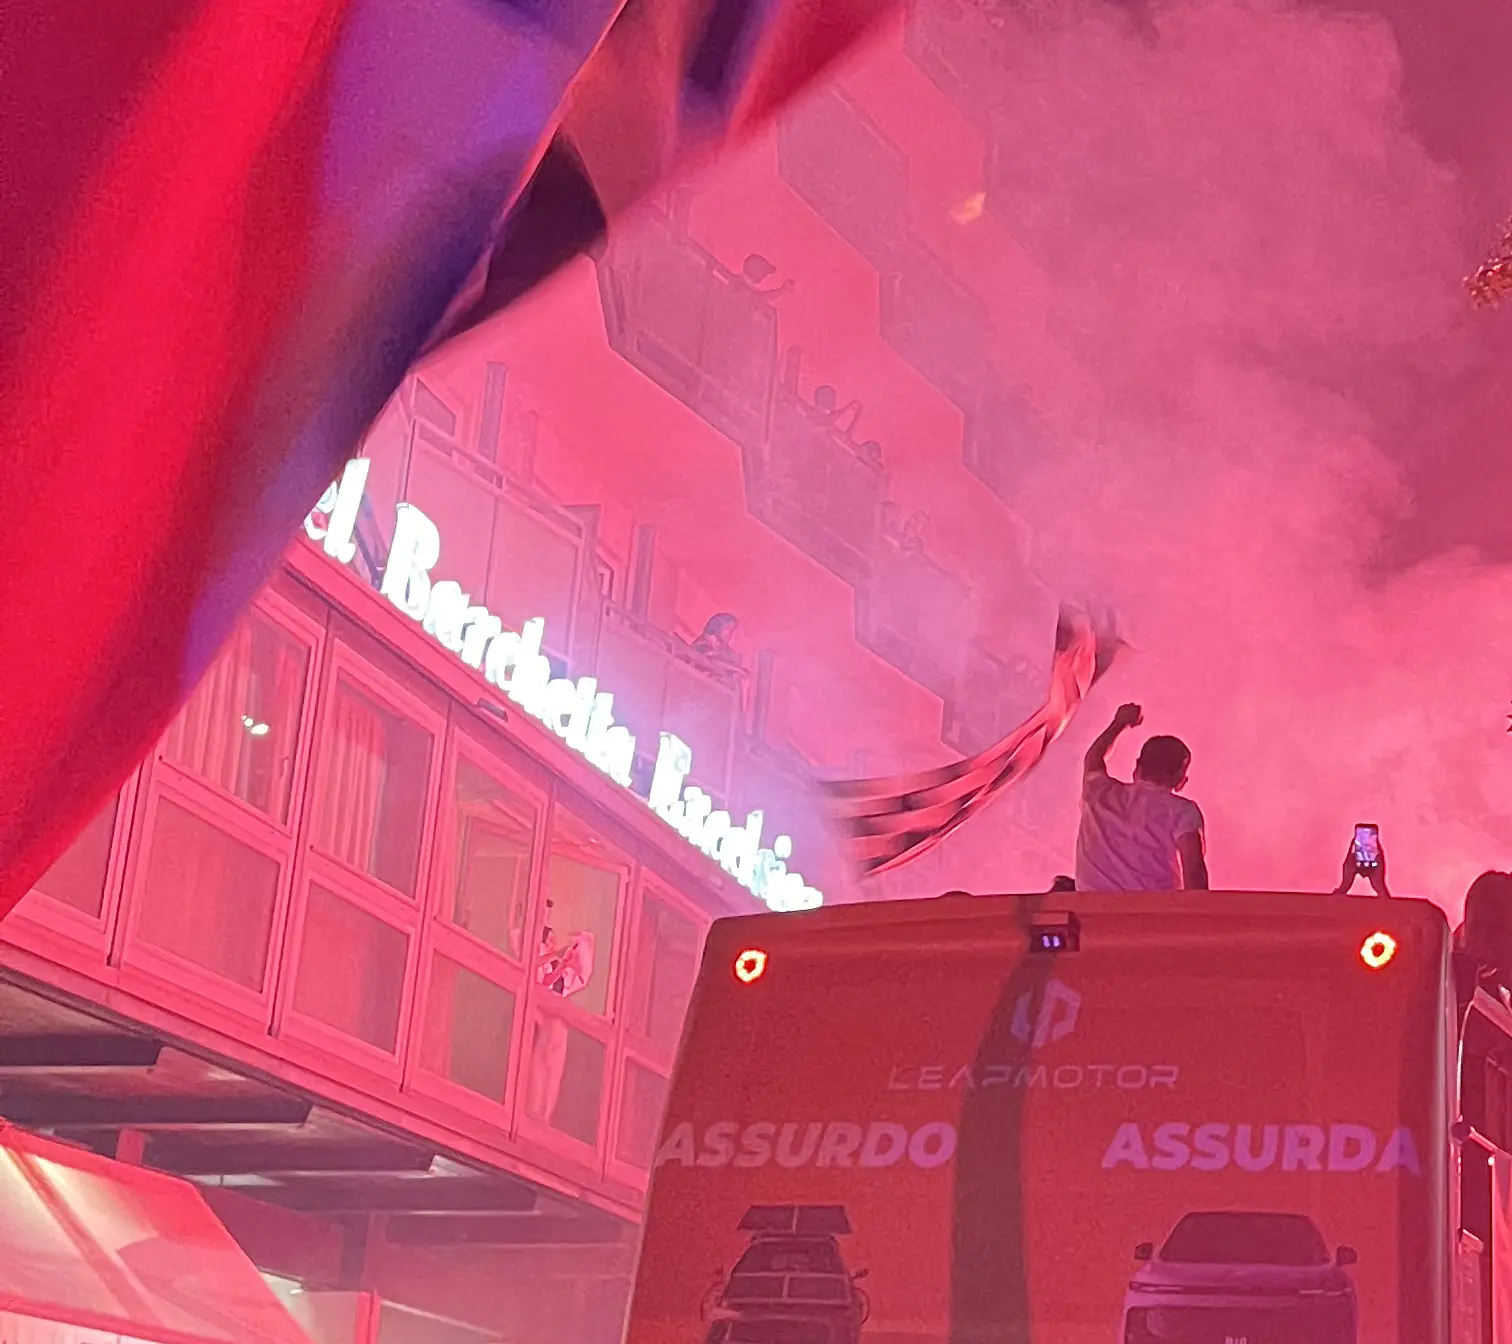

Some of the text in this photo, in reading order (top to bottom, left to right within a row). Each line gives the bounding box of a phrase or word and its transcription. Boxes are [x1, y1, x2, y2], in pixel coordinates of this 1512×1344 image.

[886, 1064, 1180, 1091] LEAPMOTOR
[655, 1120, 958, 1170] ASSURDO
[1101, 1121, 1423, 1176] ASSURDA
